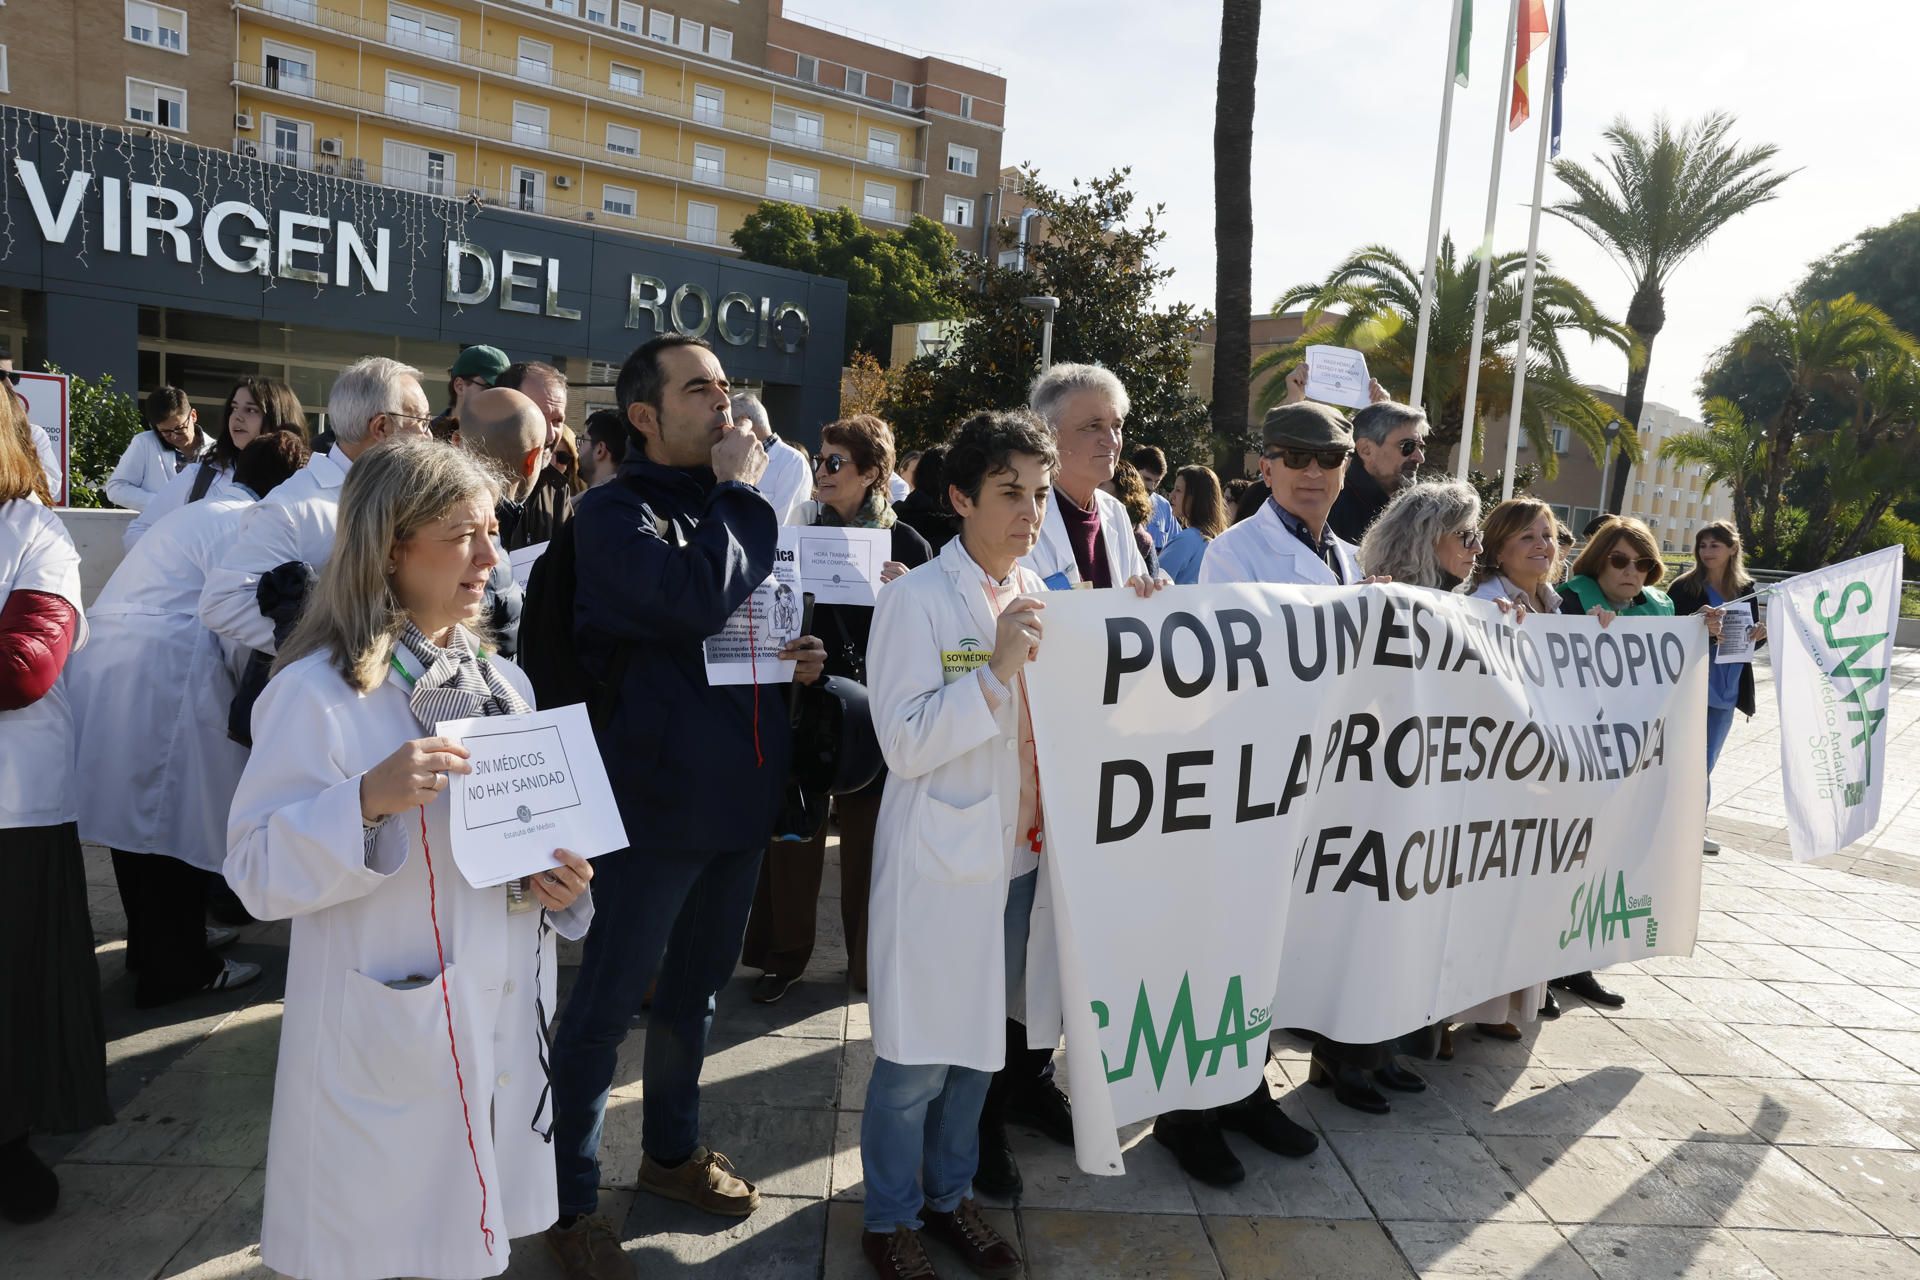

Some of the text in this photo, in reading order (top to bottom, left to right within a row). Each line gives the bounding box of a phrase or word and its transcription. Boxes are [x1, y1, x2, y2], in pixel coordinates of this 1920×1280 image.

[14, 158, 811, 354] VIRGEN DEL ROCIO
[946, 653, 963, 662] SOY
[1103, 609, 1269, 705] POR
[1280, 596, 1369, 682] UN
[1546, 632, 1685, 688] PROPIO
[1813, 581, 1890, 787] SMA
[475, 751, 545, 776] SIN MÉDICOS
[1808, 735, 1834, 799] Sevilla
[1819, 671, 1847, 790] Médico Andaluz
[468, 770, 566, 801] NO HAY SANIDAD
[1096, 750, 1214, 845] DE
[1236, 733, 1313, 824] LA
[1316, 707, 1570, 795] PROFESIÓN
[1305, 817, 1594, 902] FACULTATIVA
[1627, 894, 1652, 909] Sevilla
[1559, 866, 1652, 952] SMA
